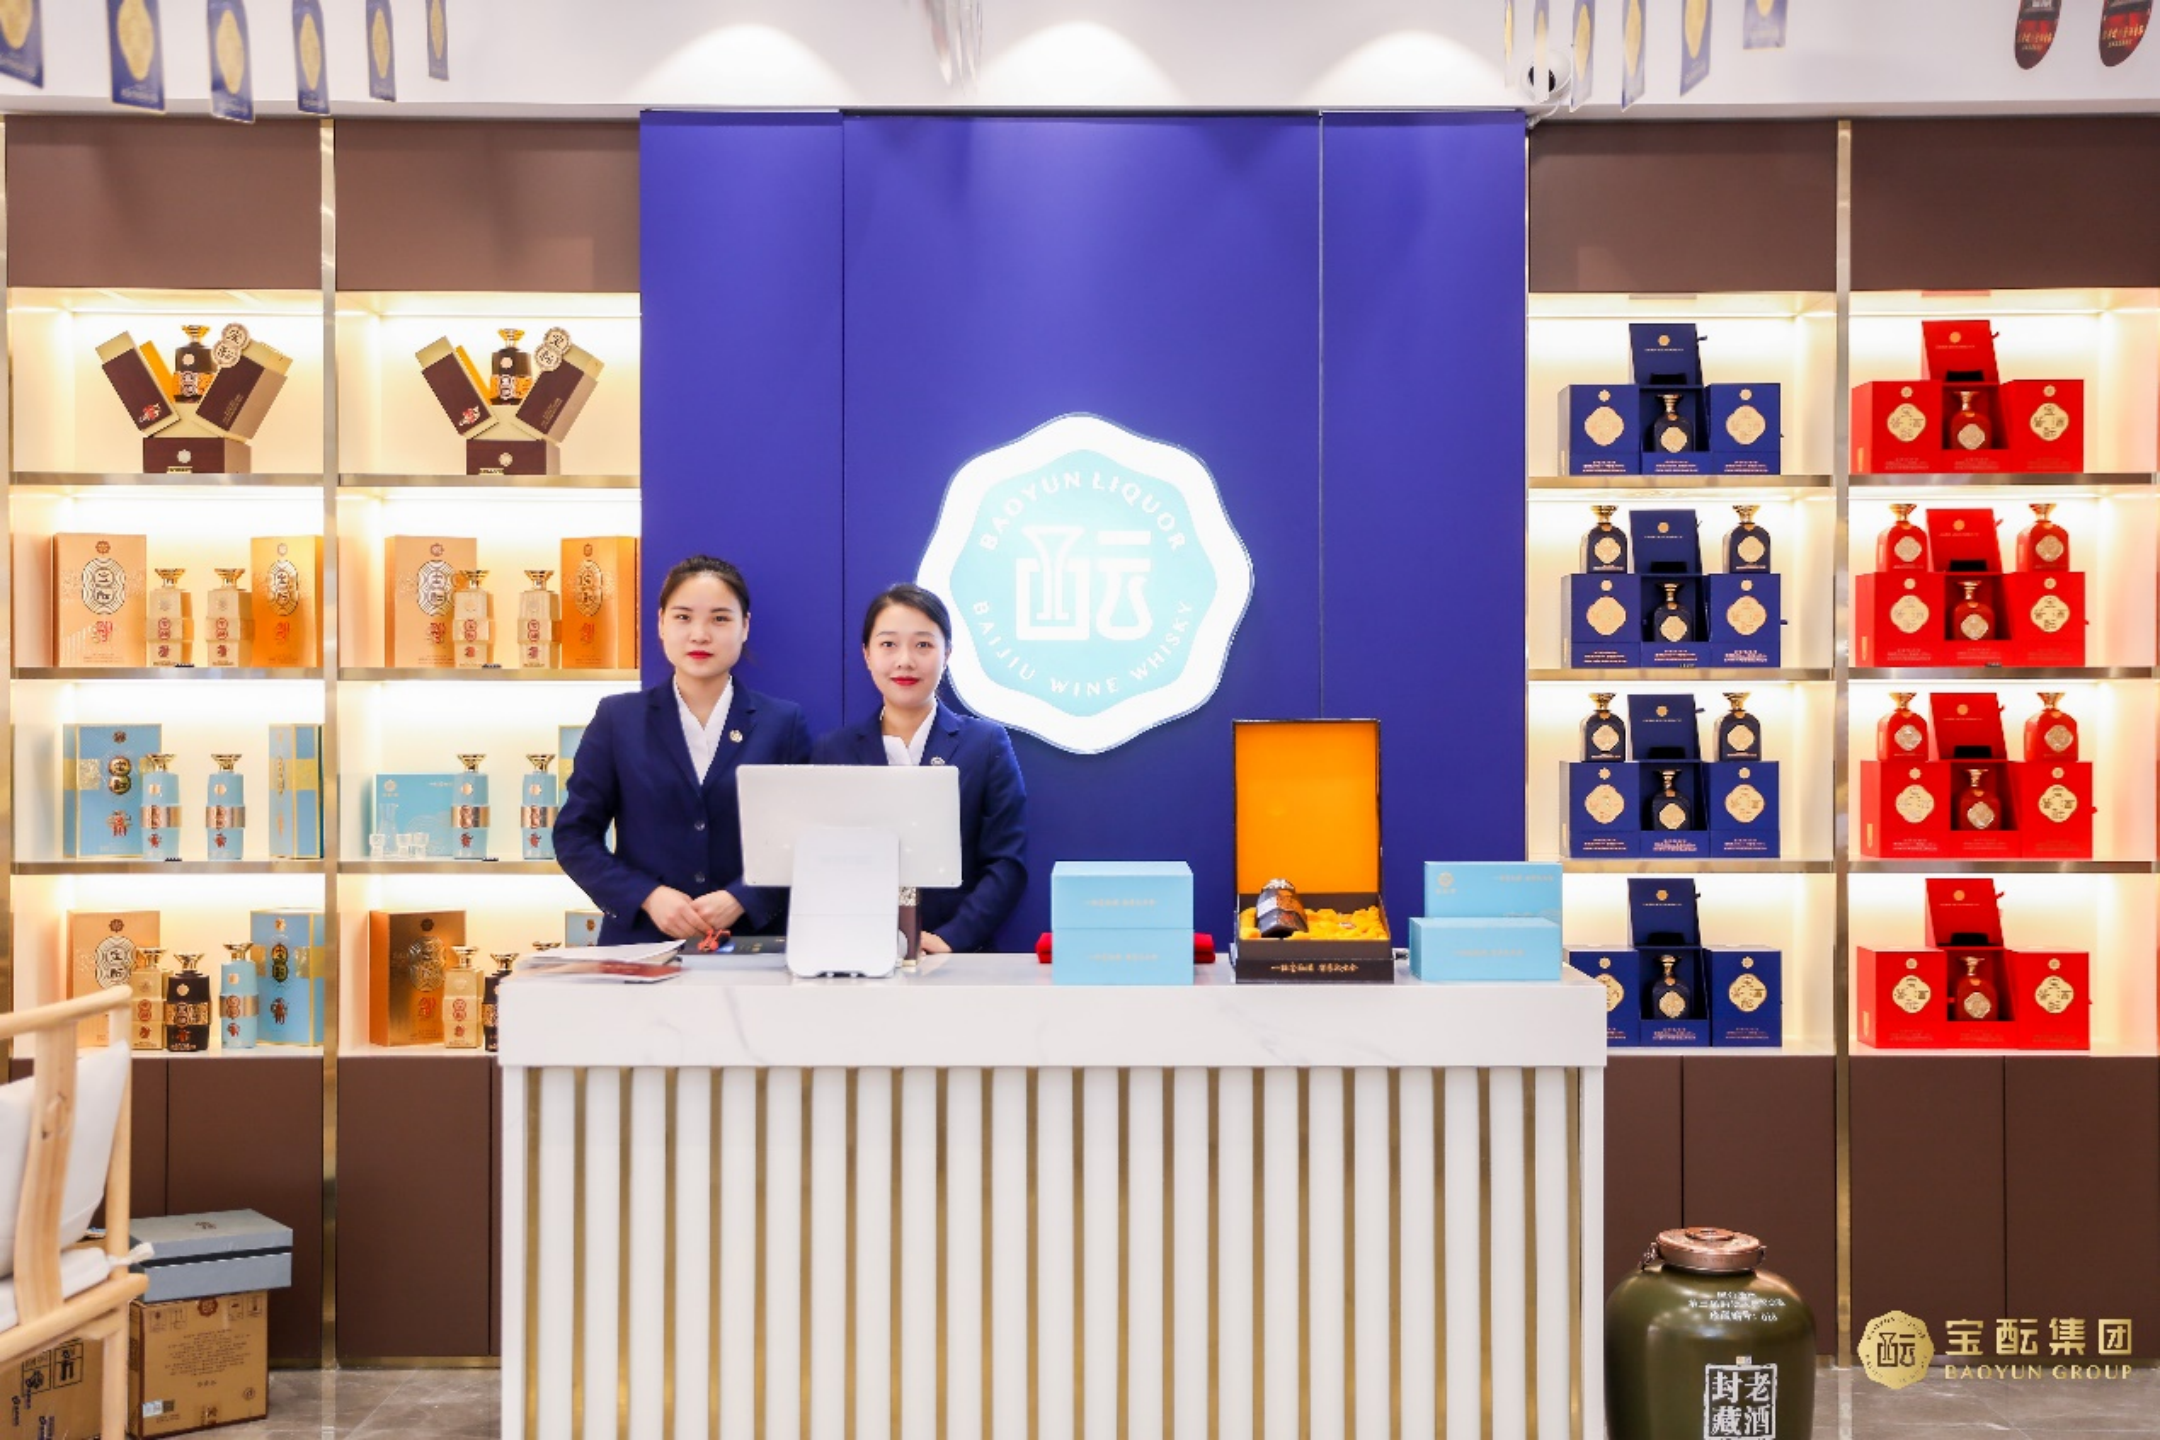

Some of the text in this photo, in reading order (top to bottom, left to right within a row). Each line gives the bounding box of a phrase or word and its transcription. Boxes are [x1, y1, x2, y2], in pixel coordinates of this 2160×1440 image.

[978, 471, 1186, 551] BAOYUN LIQUOR
[973, 599, 1193, 698] BAIJIU WINE WHISKY
